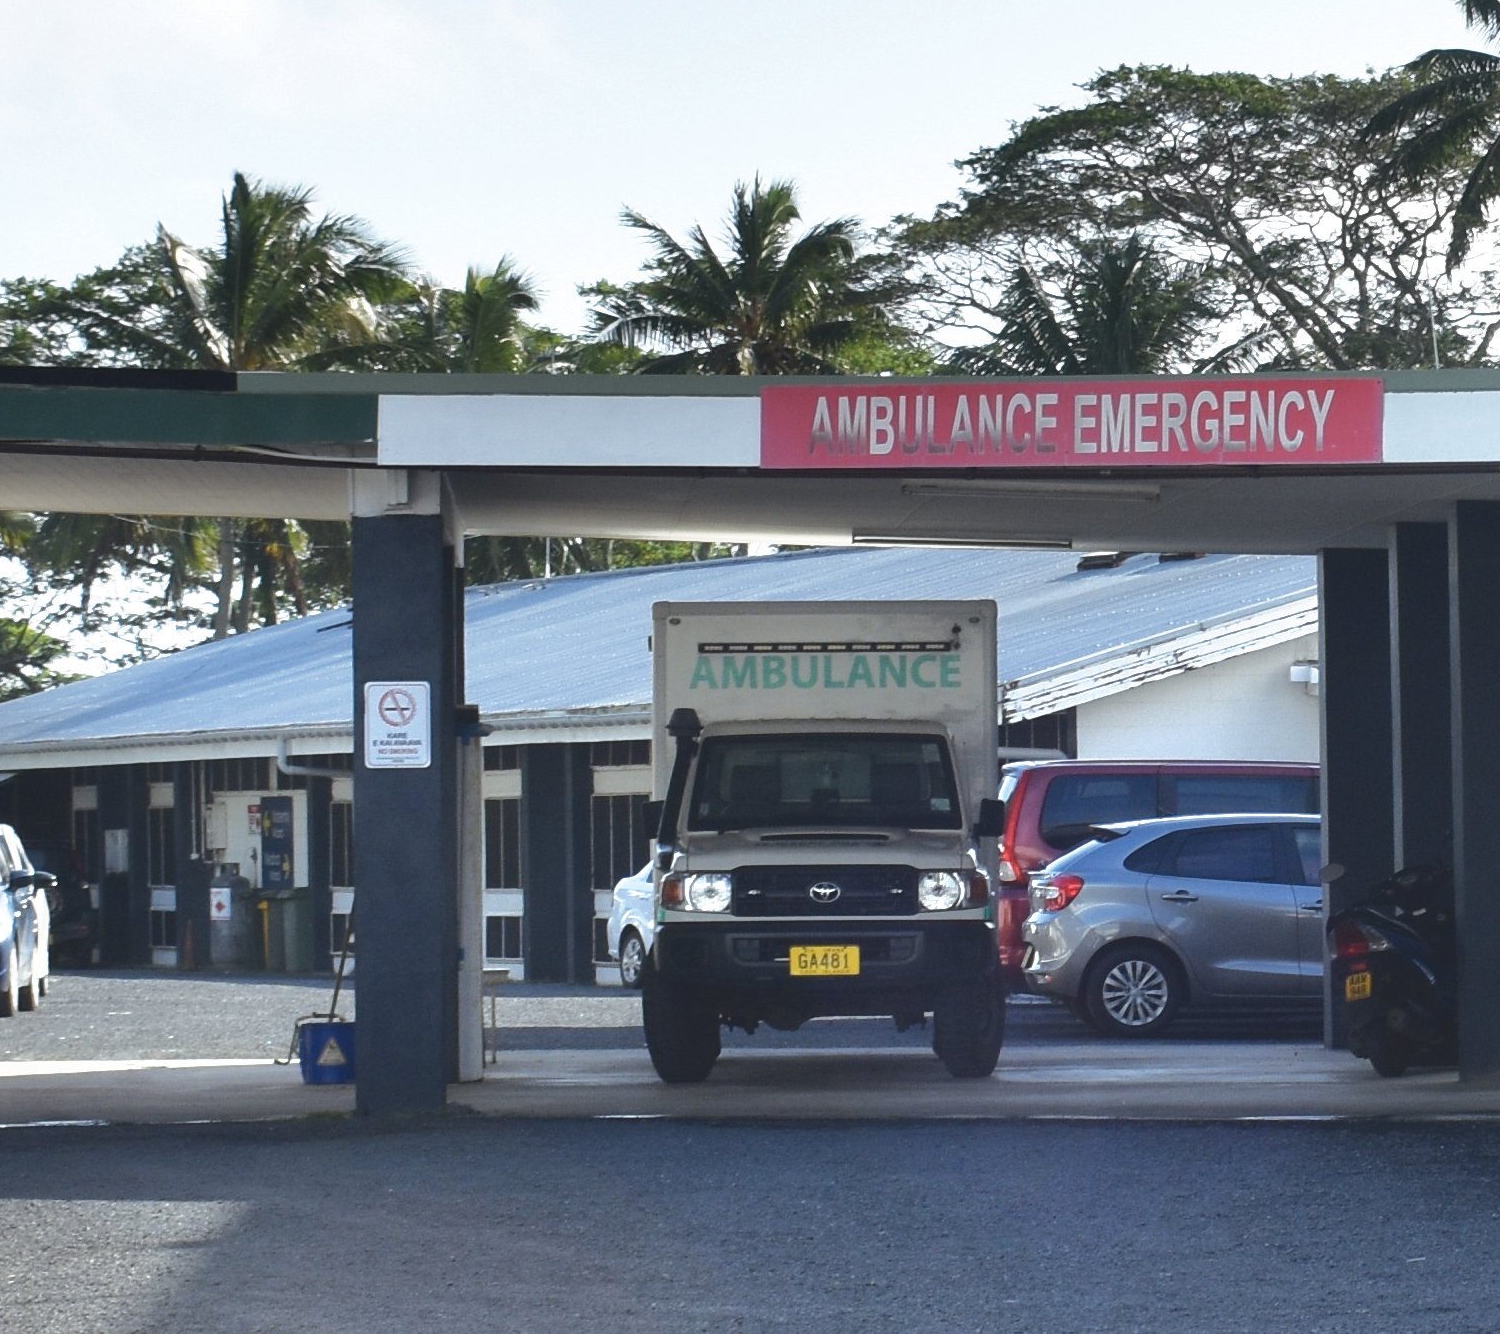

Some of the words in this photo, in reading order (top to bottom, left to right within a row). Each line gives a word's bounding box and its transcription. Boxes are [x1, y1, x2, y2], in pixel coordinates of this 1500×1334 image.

[808, 394, 1057, 456] AMBULANCE
[1073, 390, 1335, 454] EMERGENCY
[690, 654, 962, 689] AMBULANCE
[798, 953, 849, 969] GA481
